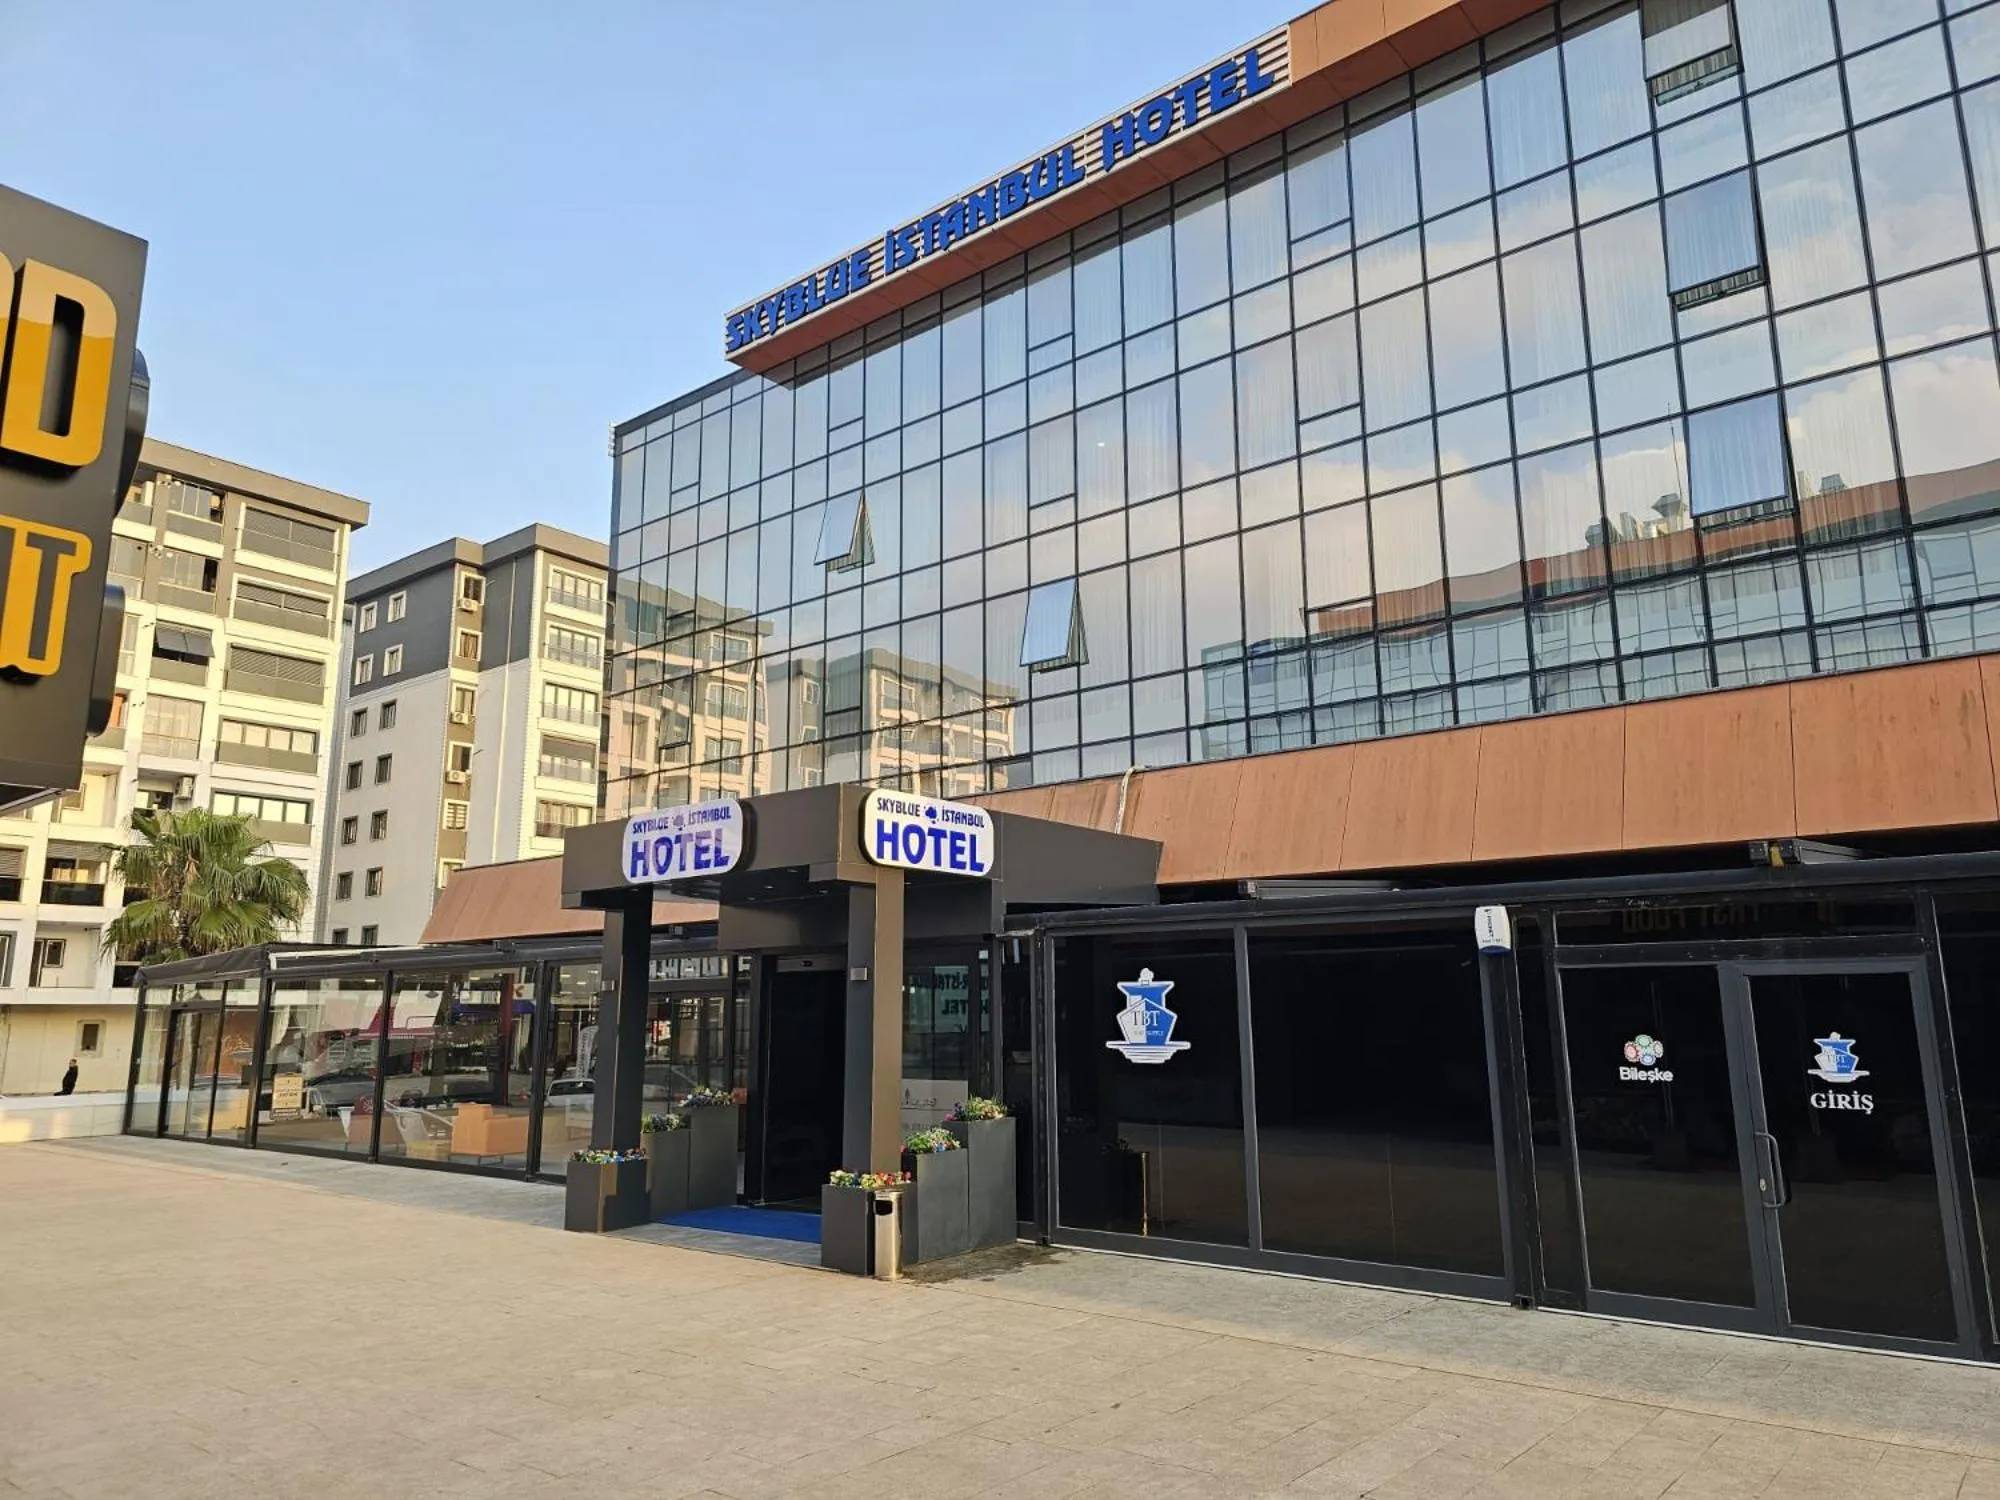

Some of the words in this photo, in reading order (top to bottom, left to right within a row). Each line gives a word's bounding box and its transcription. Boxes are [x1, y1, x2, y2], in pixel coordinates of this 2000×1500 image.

[726, 247, 871, 350] SKYBLUE
[884, 143, 1085, 274] İSTANBUL
[1101, 47, 1275, 172] HOTEL
[0, 252, 118, 467] D
[632, 814, 669, 835] SKYBLUE
[876, 796, 921, 818] SKYBLUE
[629, 827, 730, 878] HOTEL
[876, 818, 985, 873] HOTEL
[1619, 1065, 1675, 1084] Bileşke
[1810, 1089, 1875, 1115] GİRİŞ
